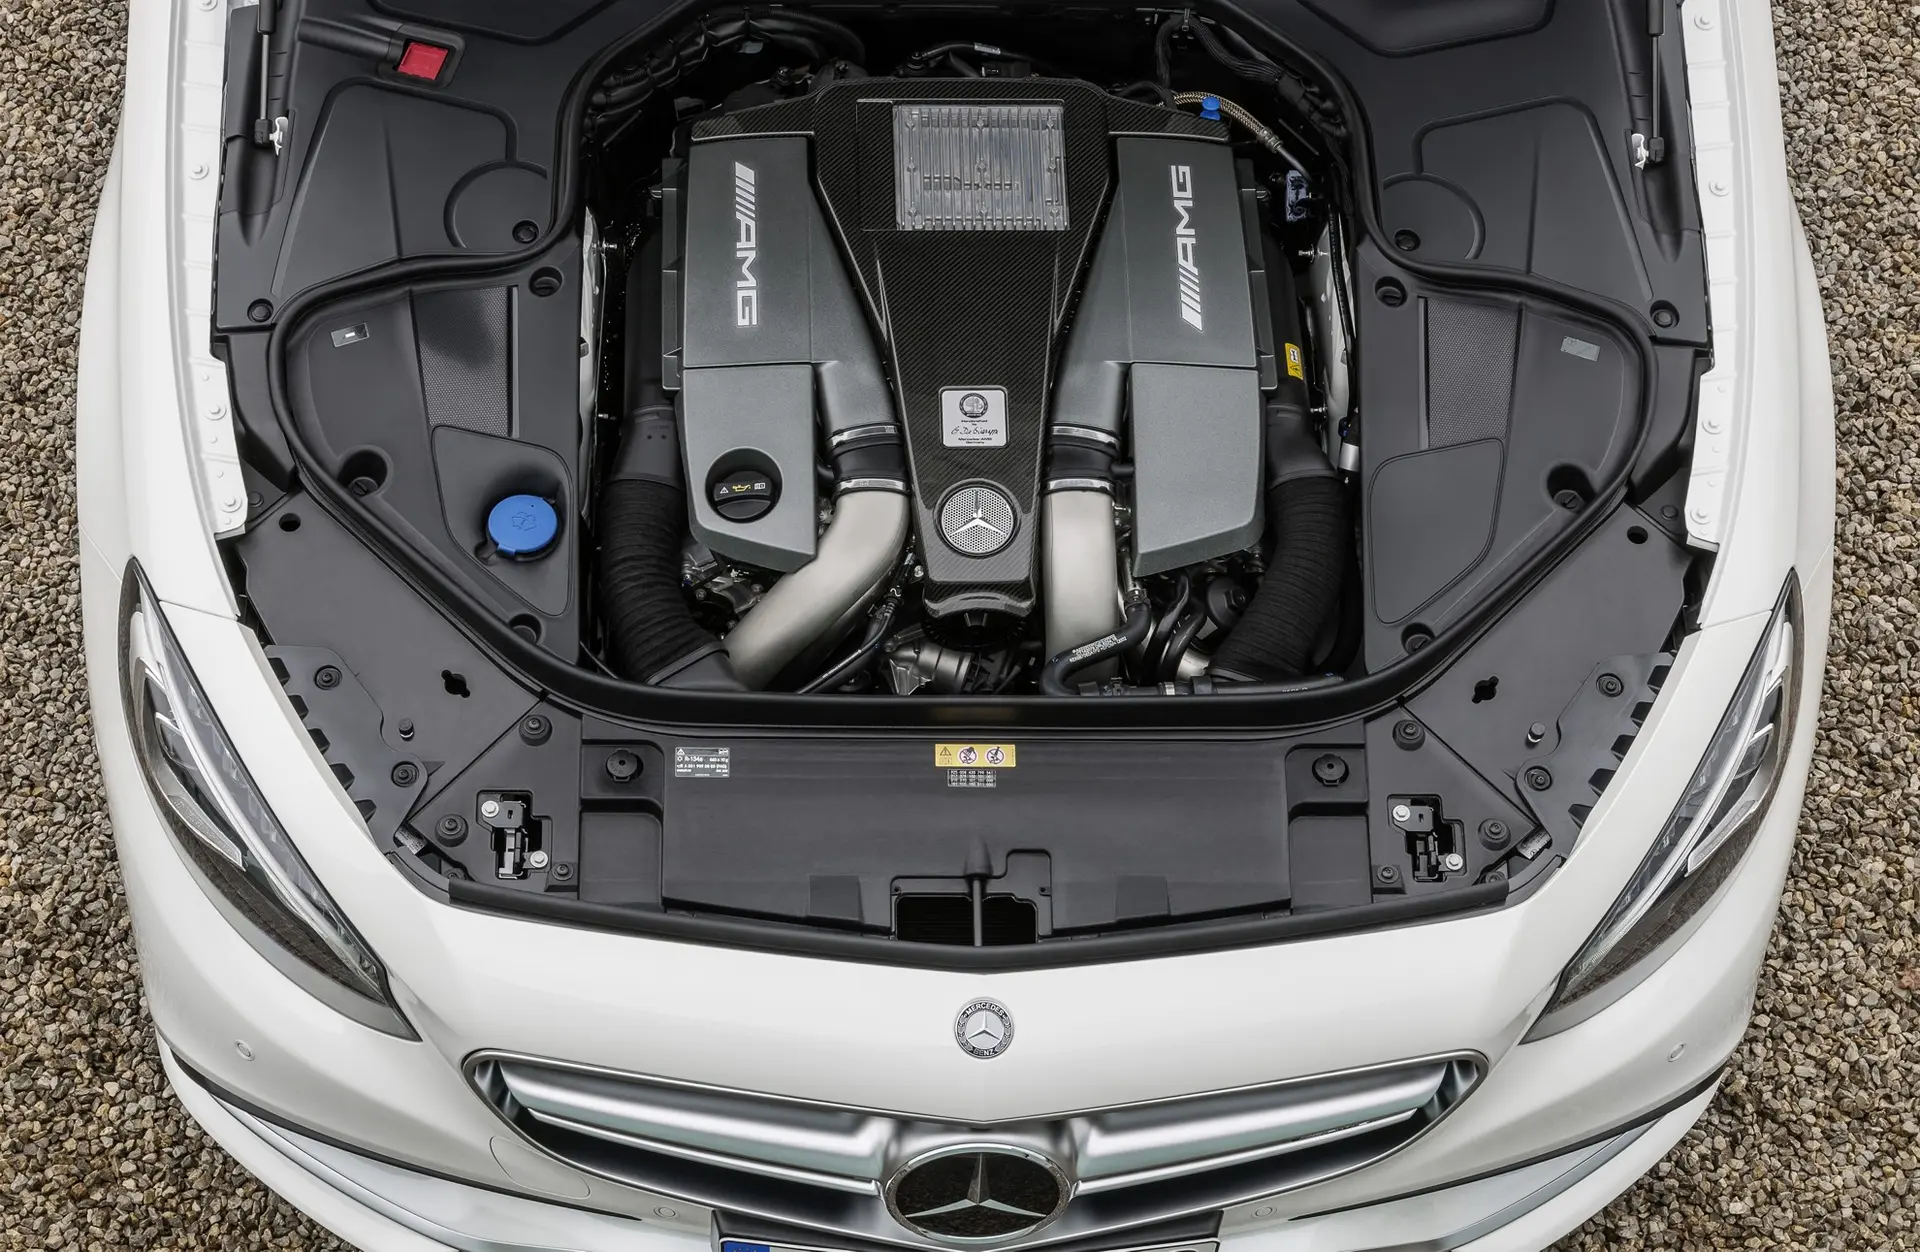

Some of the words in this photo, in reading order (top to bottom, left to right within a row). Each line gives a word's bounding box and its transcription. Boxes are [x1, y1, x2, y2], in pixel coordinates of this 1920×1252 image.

[1170, 165, 1199, 276] AMG
[735, 211, 757, 326] AMG
[965, 1002, 1005, 1016] MERCEDES
[973, 1048, 995, 1056] BENZ
